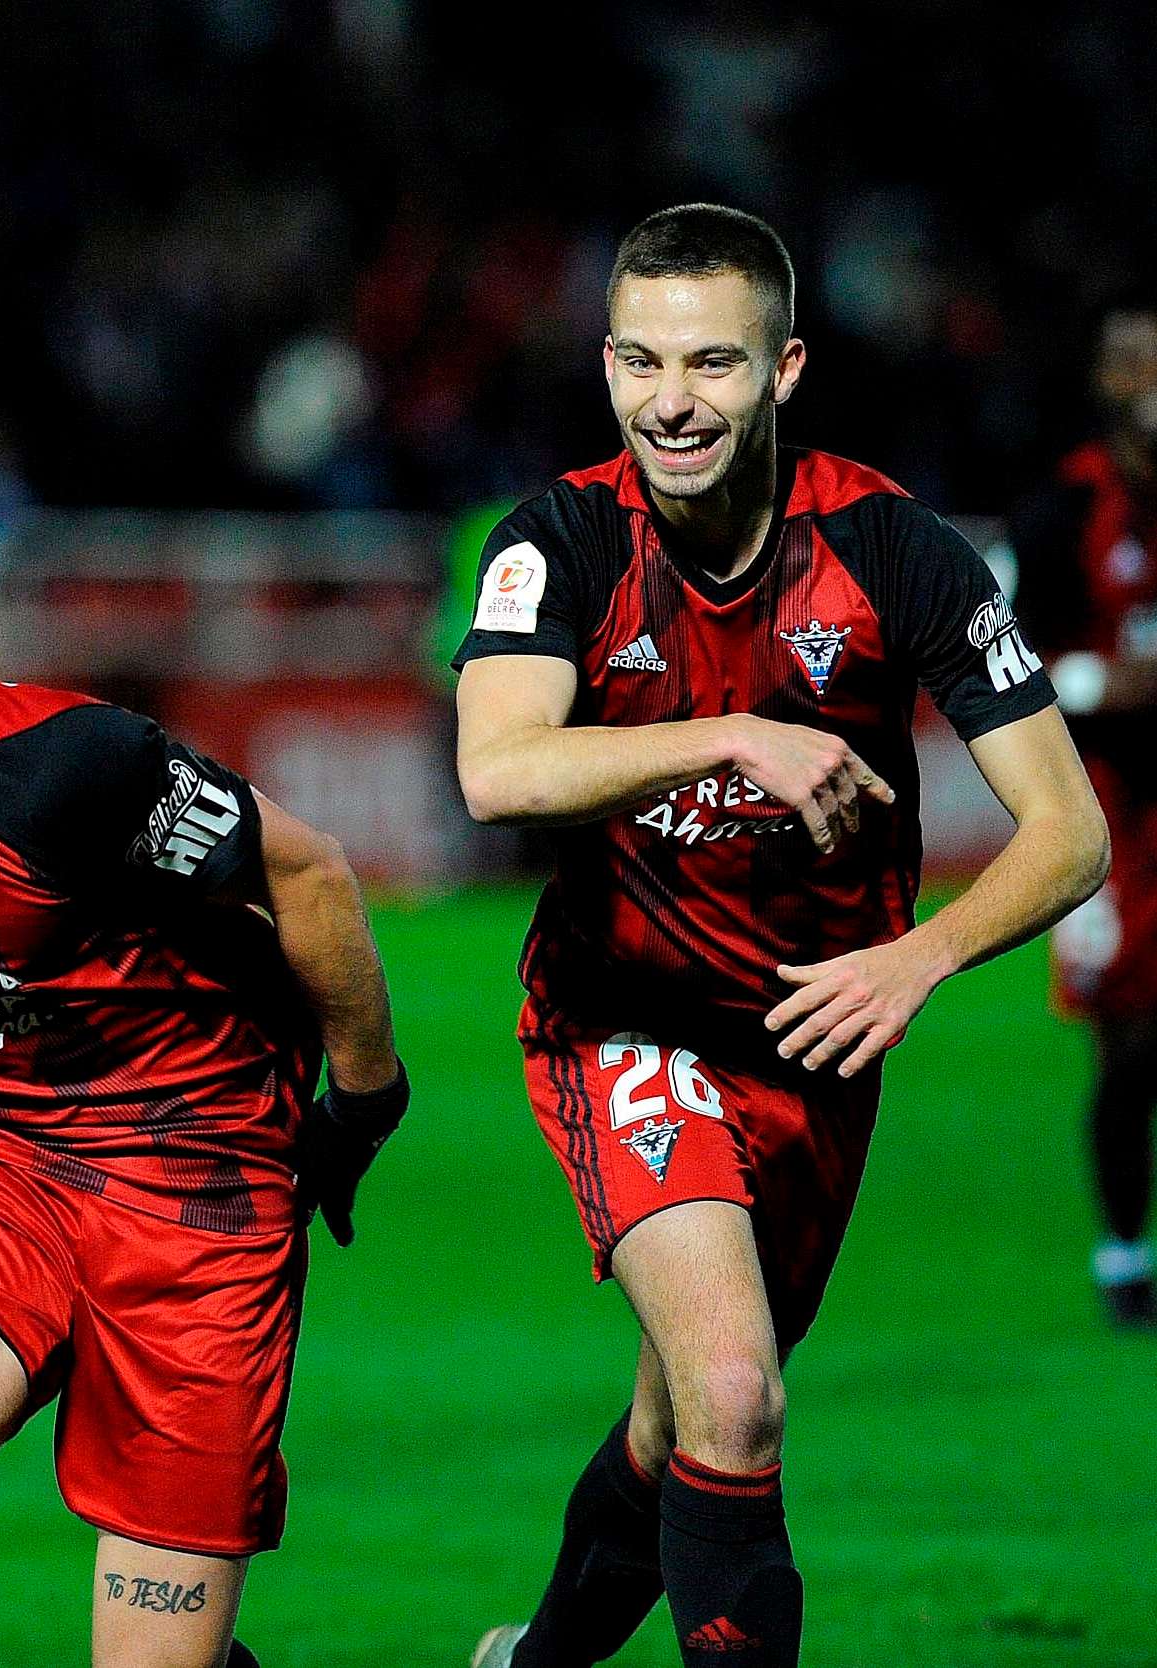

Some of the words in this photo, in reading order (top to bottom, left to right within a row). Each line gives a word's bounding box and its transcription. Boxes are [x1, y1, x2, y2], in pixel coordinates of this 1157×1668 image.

[492, 597, 517, 606] COPA
[607, 655, 668, 672] adidas
[125, 759, 198, 864] William
[154, 780, 241, 876] HILL
[598, 1031, 724, 1131] 26
[128, 1577, 206, 1615] JESUS
